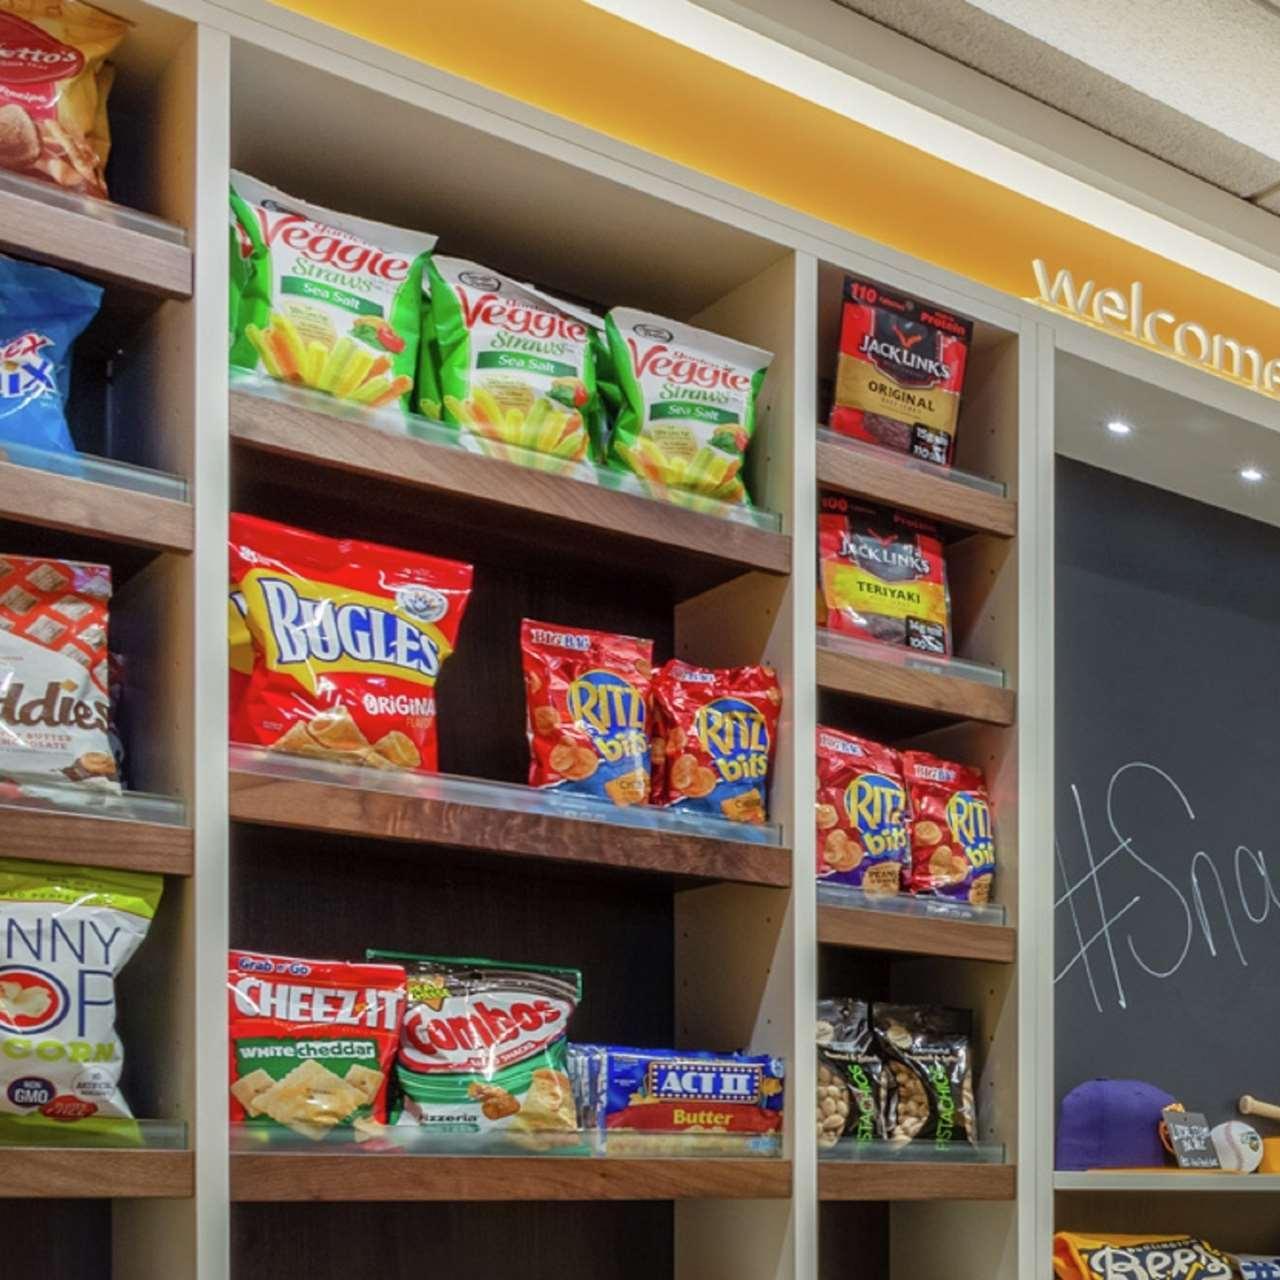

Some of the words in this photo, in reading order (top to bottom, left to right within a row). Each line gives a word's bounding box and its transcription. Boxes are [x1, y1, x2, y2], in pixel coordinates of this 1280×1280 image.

[256, 207, 409, 282] Veggie
[292, 257, 372, 292] Straws
[303, 282, 330, 299] Sea
[333, 290, 361, 310] Salt
[456, 286, 590, 342] Veggie
[490, 330, 567, 356] Straws
[498, 355, 525, 370] Sea
[528, 358, 555, 375] Salt
[627, 337, 751, 392] Veggie
[658, 382, 732, 405] Straws
[868, 379, 936, 413] ORIGINAL
[669, 404, 694, 418] Sea
[696, 407, 720, 422] Salt
[855, 580, 921, 605] TERIYAKI
[257, 577, 441, 678] BUGLES
[568, 680, 645, 734] RITZ
[695, 706, 770, 755] RITZ
[715, 752, 769, 783] bits
[239, 958, 272, 974] Grab
[289, 964, 311, 977] Go
[297, 1041, 376, 1058] cheddar
[661, 1069, 713, 1094] ACT
[720, 1071, 752, 1096] II
[14, 1088, 49, 1105] GMO
[672, 1108, 734, 1126] Butter
